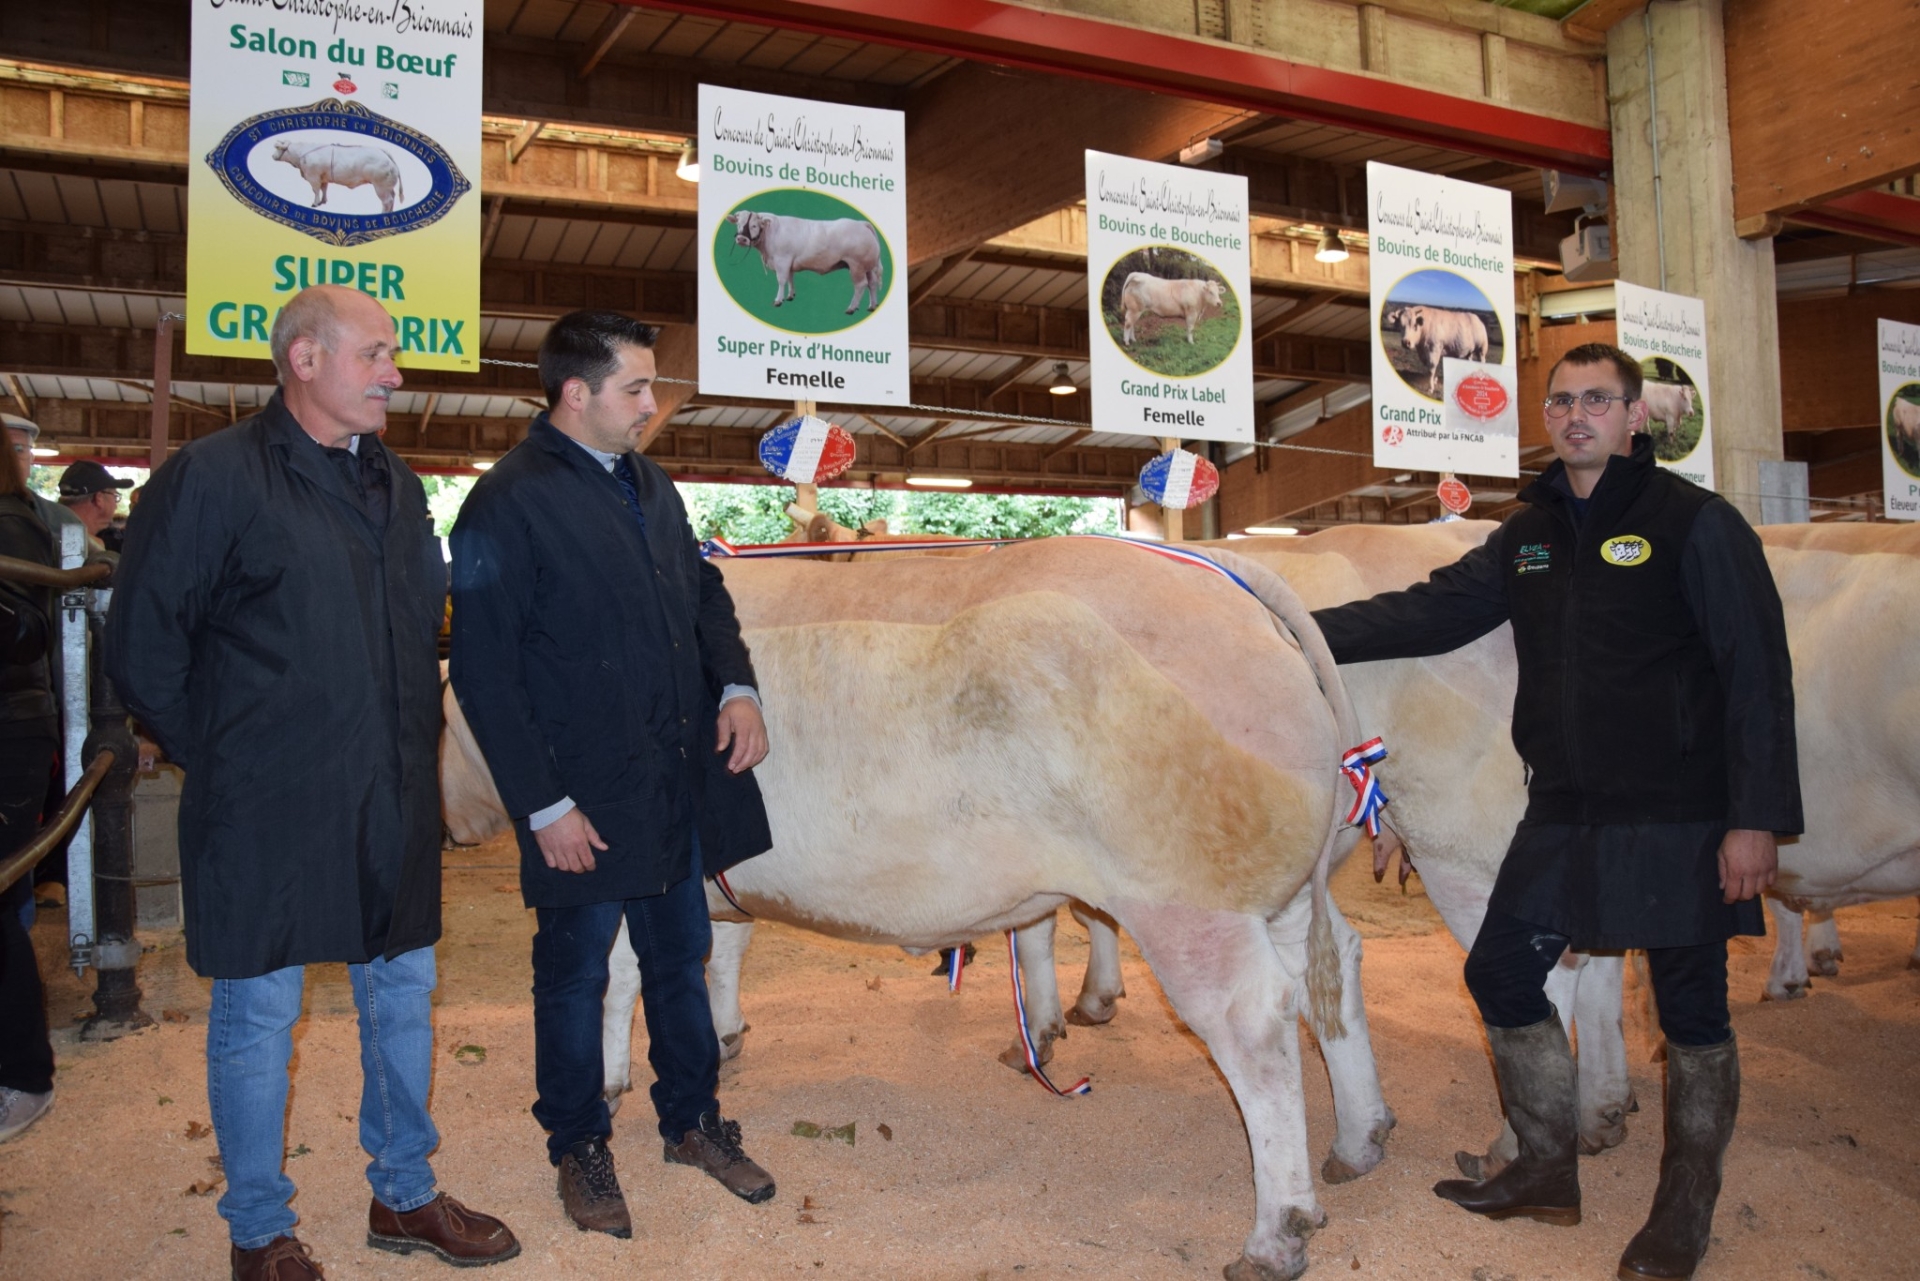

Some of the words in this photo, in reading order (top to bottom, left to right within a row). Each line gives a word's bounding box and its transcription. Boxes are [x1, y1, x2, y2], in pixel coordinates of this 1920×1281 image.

[229, 24, 317, 59] Salon
[327, 38, 364, 66] du
[376, 45, 457, 78] Bœuf
[248, 128, 263, 142] ST
[270, 116, 347, 132] CHRISTOPHE
[373, 125, 437, 165] BRIONNAIS
[753, 118, 764, 146] de
[713, 154, 774, 178] Bovins
[778, 162, 801, 182] de
[805, 166, 895, 193] Boucherie
[230, 165, 290, 214] CONCOURS
[312, 214, 360, 229] BOVINS
[384, 190, 446, 227] BOUCHERIE
[1098, 213, 1147, 237] Bovins
[1149, 222, 1168, 241] de
[1171, 225, 1242, 251] Boucherie
[1377, 236, 1421, 260] Bovins
[1424, 244, 1440, 262] de
[1442, 247, 1505, 274] Boucherie
[273, 255, 406, 301] SUPER
[717, 335, 765, 359] Super
[769, 340, 802, 359] Prix
[806, 342, 892, 365] d'Honneur
[1623, 331, 1649, 350] Bovins
[1650, 337, 1660, 352] de
[1661, 340, 1702, 359] Boucherie
[766, 367, 846, 390] Femelle
[1882, 360, 1906, 376] Bovins
[1907, 364, 1917, 377] de
[1121, 380, 1159, 398] Grand
[1164, 384, 1188, 400] Prix
[1192, 387, 1226, 403] Label
[1144, 407, 1205, 426] Femelle
[1379, 404, 1416, 424] Grand
[1418, 407, 1442, 426] Prix
[1406, 427, 1437, 439] Attribué
[1438, 433, 1451, 441] par
[1451, 432, 1459, 441] la
[1460, 433, 1485, 443] FNCAB
